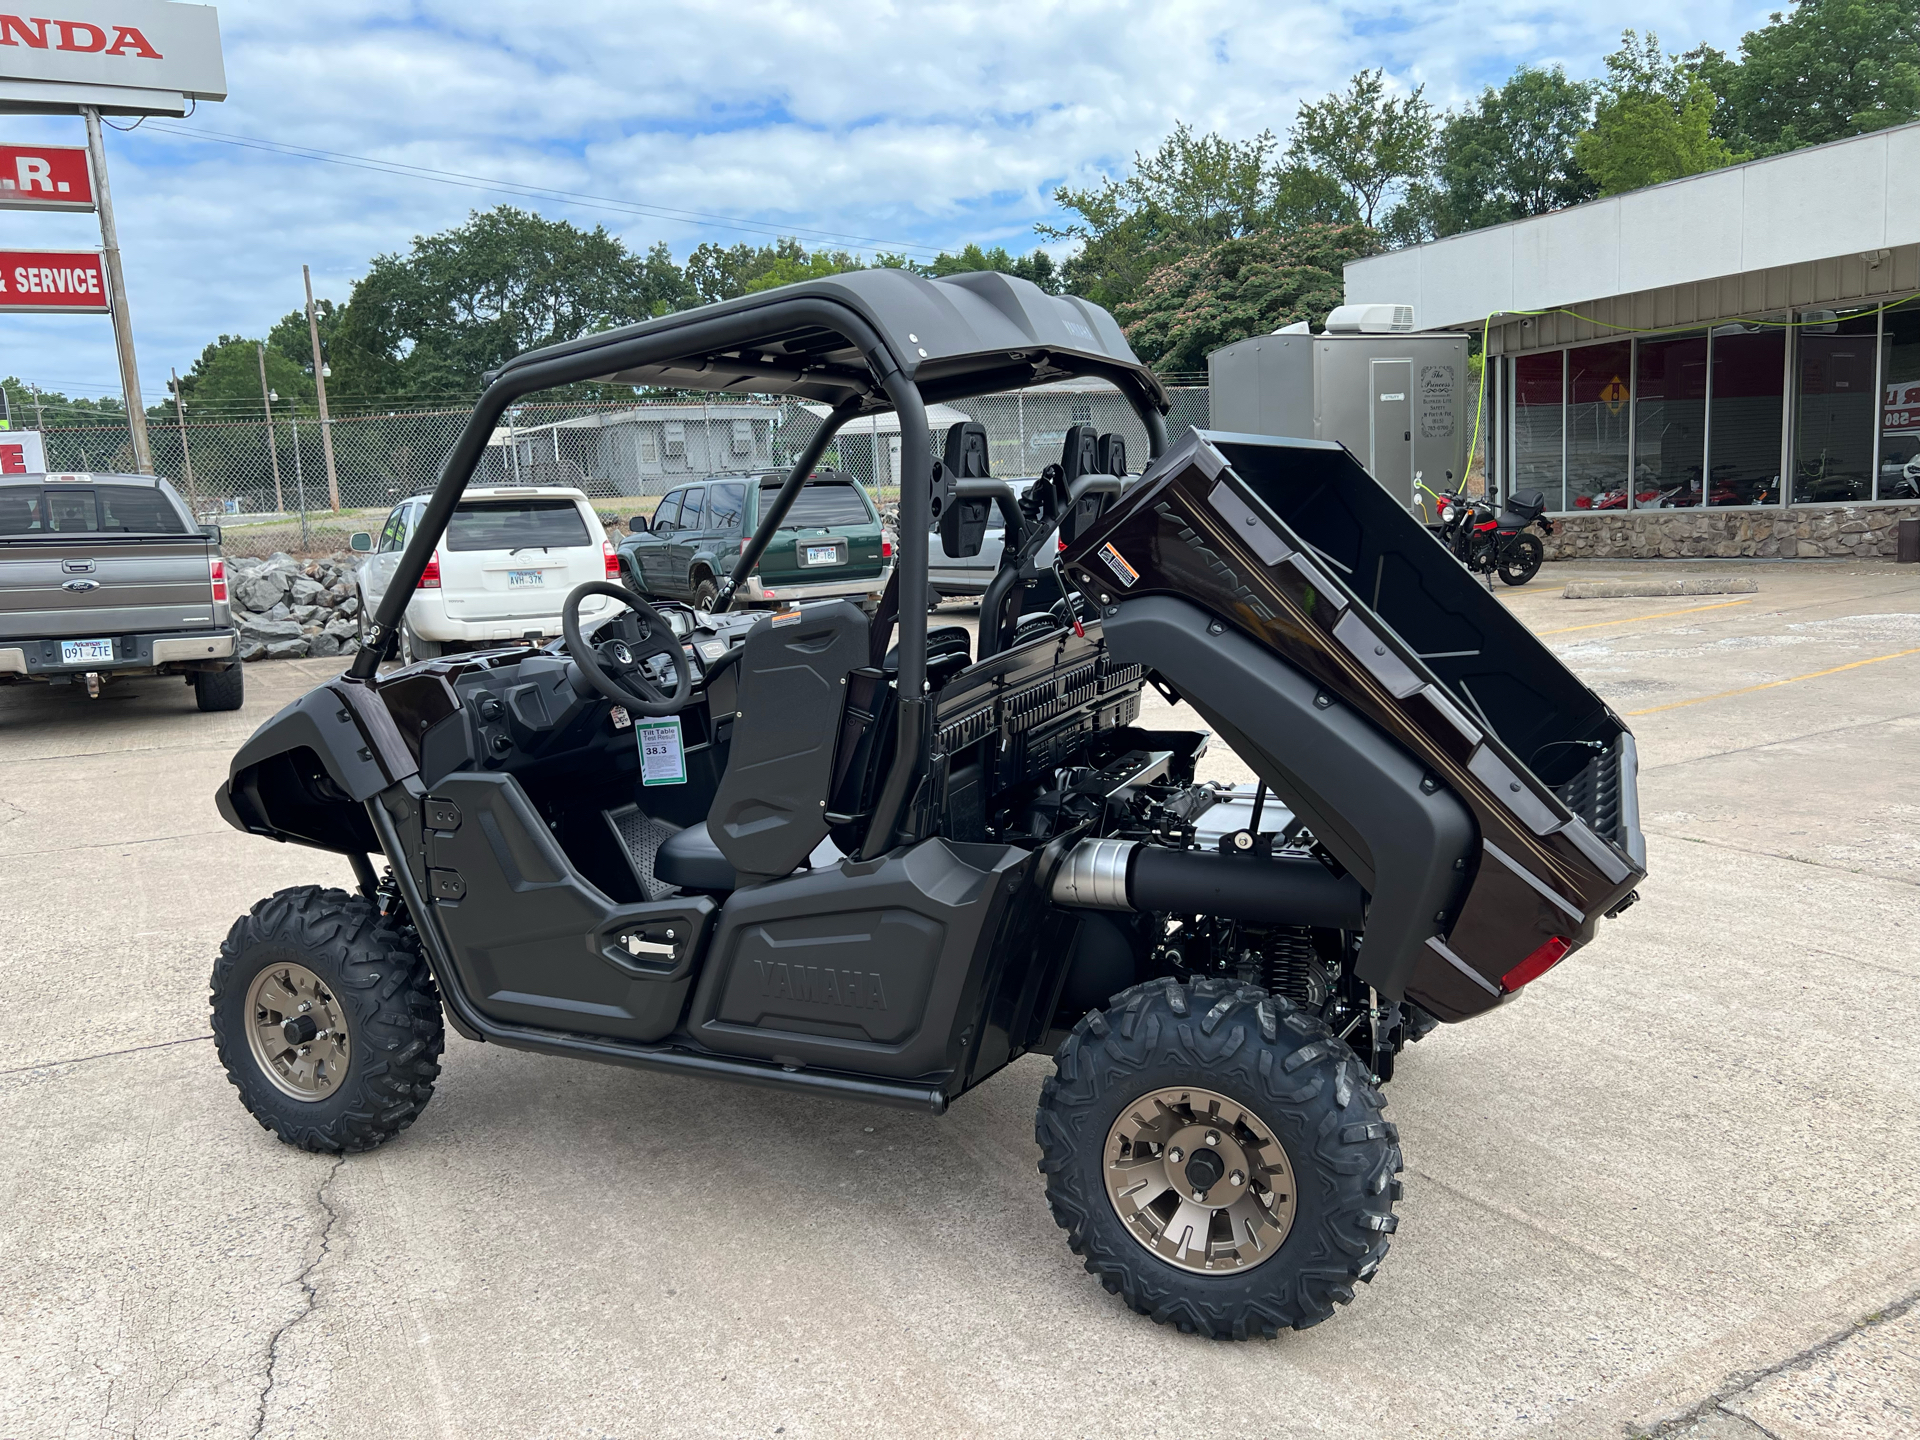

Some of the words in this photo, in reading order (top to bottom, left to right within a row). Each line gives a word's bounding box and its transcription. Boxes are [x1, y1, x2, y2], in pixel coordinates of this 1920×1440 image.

[15, 266, 100, 294] SERVICE
[1431, 371, 1443, 379] The
[1154, 501, 1277, 622] VIKING
[72, 582, 89, 590] Ford
[510, 576, 525, 585] AVH
[528, 575, 543, 584] 37K
[64, 647, 83, 659] 091
[91, 645, 111, 658] ZTE
[645, 746, 667, 756] 38.3
[753, 959, 888, 1012] YAMAHA
